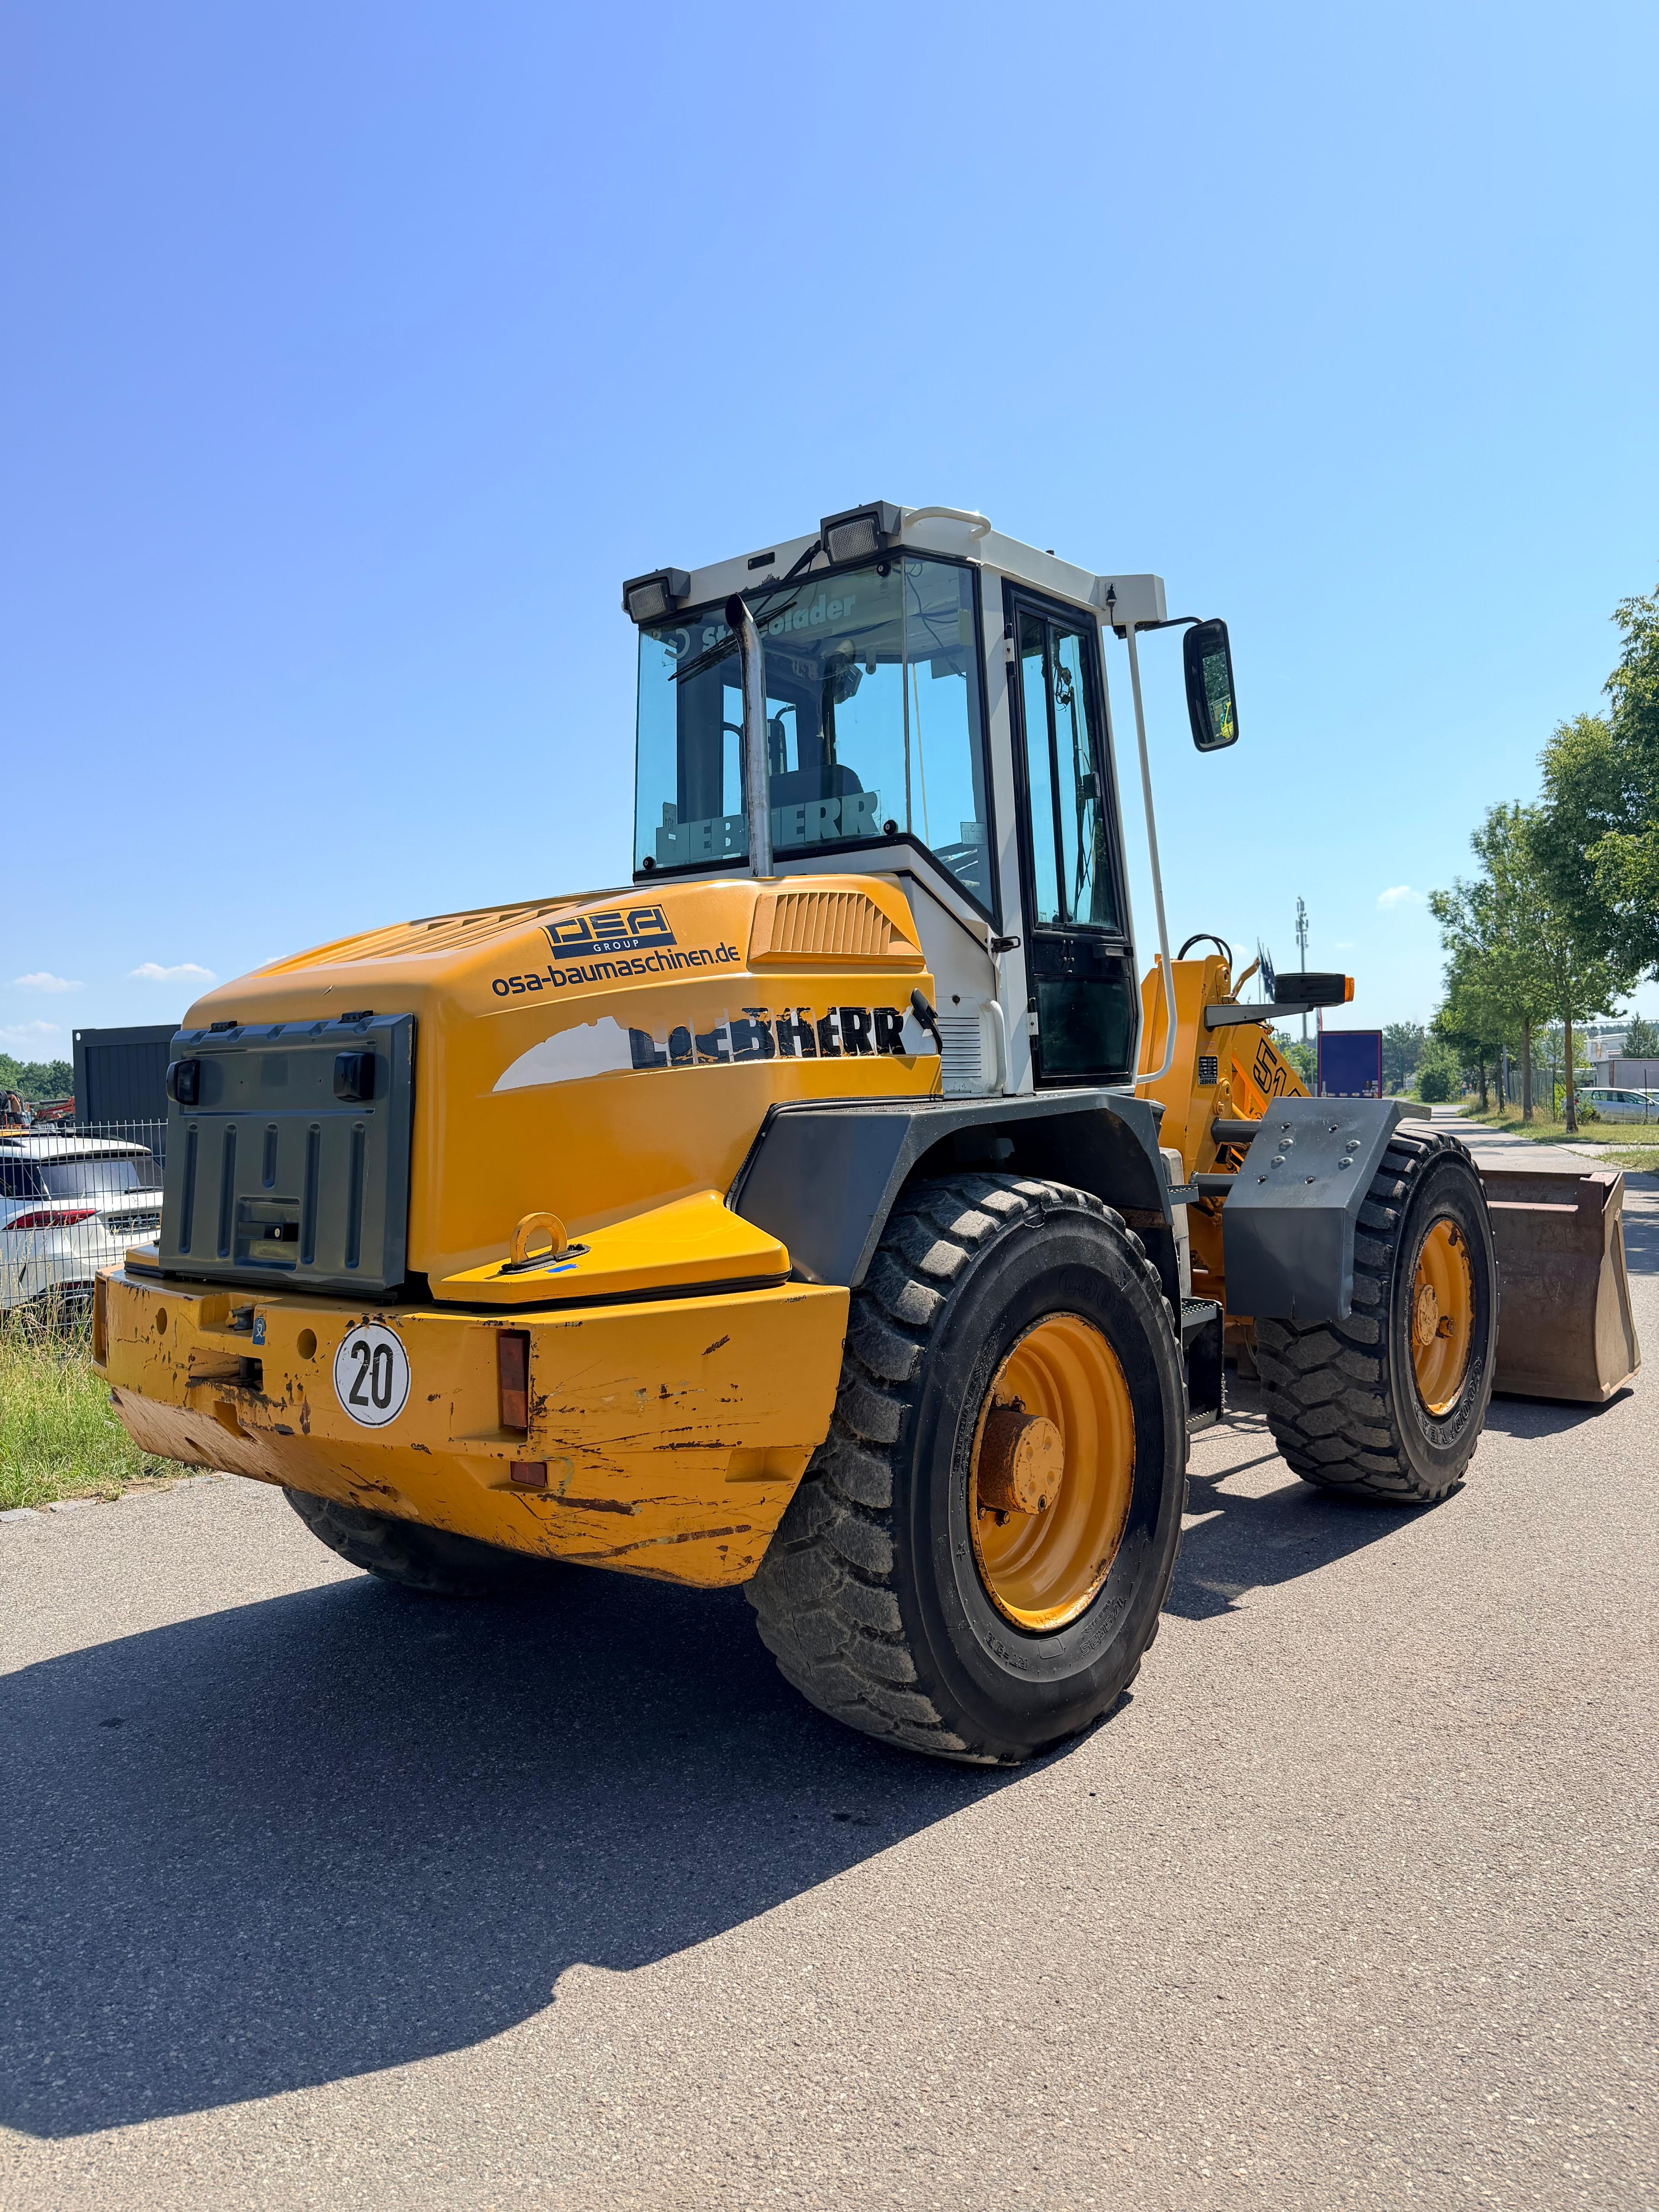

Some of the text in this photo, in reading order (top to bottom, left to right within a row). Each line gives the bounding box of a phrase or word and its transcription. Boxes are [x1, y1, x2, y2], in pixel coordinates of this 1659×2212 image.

[492, 942, 741, 996] osa-baumaschinen.de
[593, 939, 639, 952] GROUP
[1253, 1037, 1301, 1096] 51
[349, 1340, 393, 1409] 20
